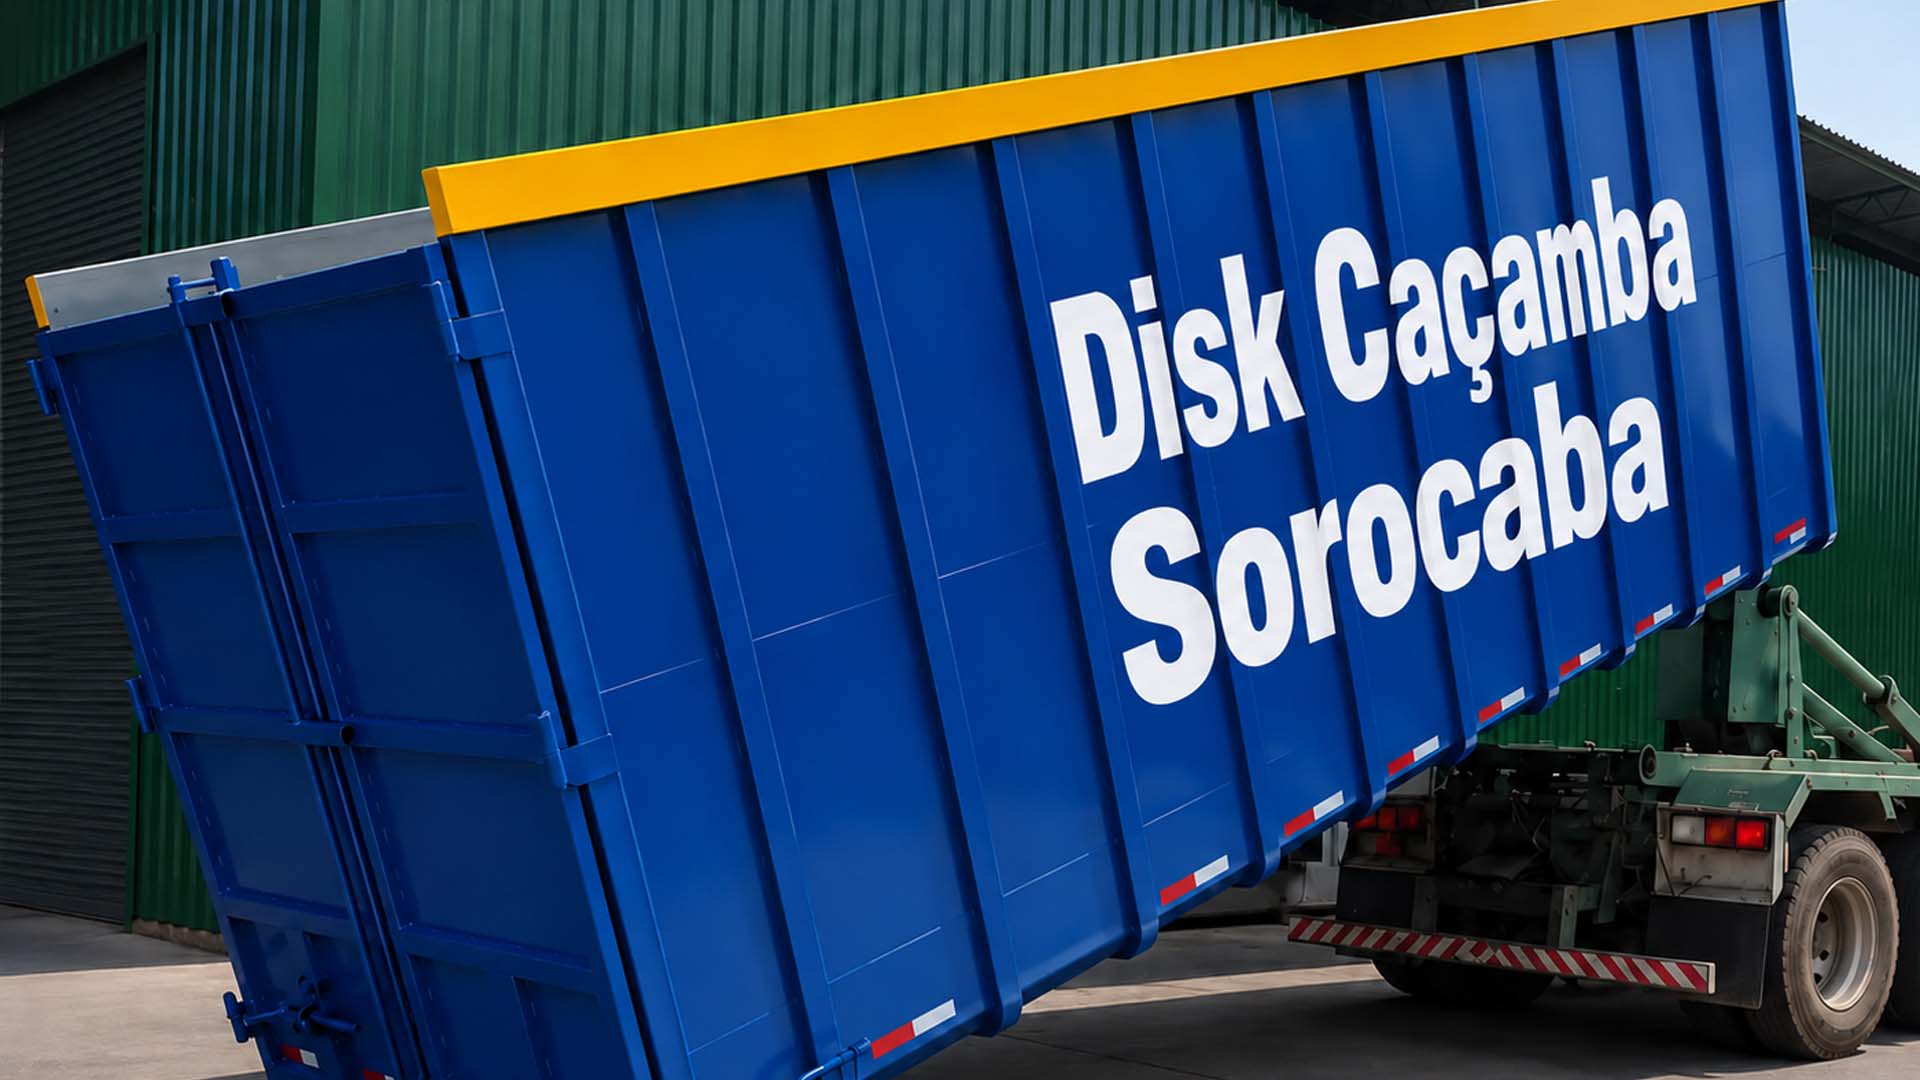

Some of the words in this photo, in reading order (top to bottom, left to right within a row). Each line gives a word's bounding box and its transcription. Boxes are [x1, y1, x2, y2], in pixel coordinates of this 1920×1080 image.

[1050, 254, 1306, 485] Disk
[1314, 176, 1697, 404] Caçamba
[1110, 381, 1669, 705] Sorocaba
